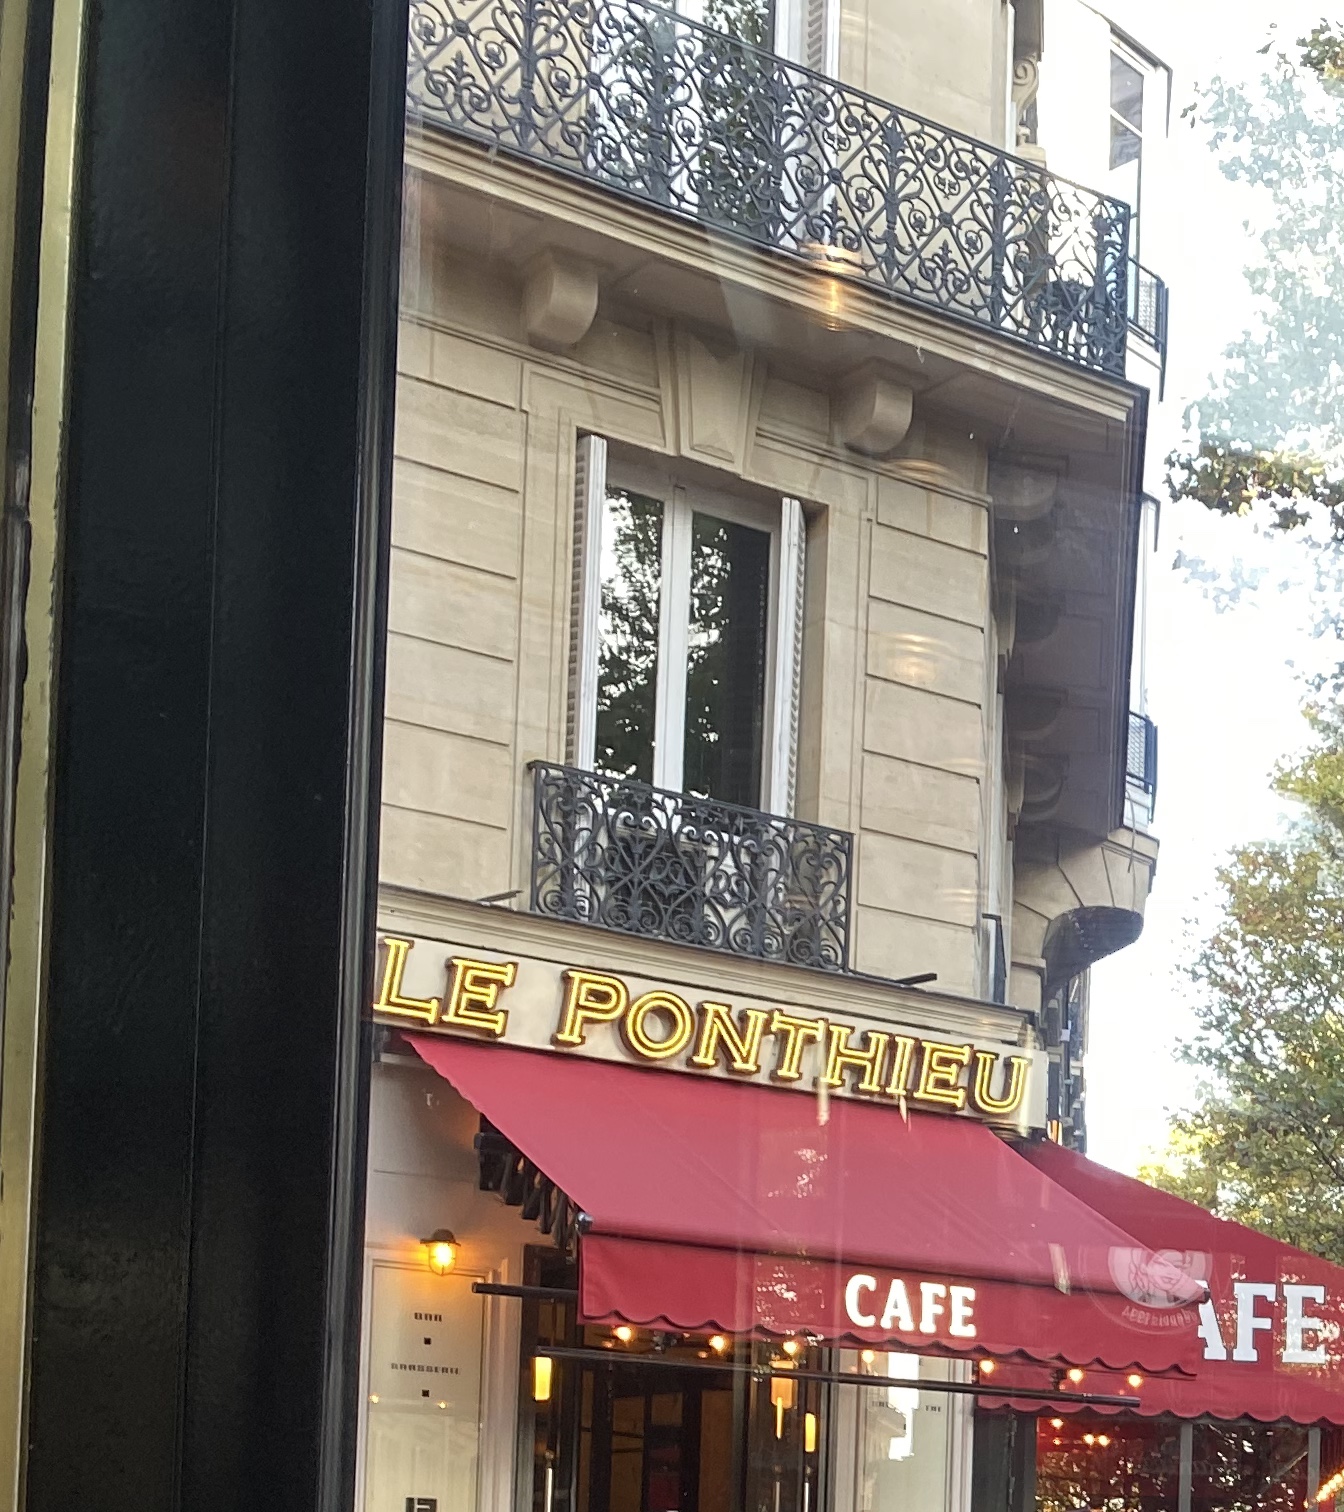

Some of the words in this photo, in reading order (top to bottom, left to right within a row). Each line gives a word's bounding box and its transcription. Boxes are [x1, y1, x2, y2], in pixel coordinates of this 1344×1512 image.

[373, 936, 518, 1037] LE
[555, 969, 1031, 1116] PONTHIEU
[844, 1273, 978, 1338] CAFE
[1196, 1279, 1327, 1364] AFE
